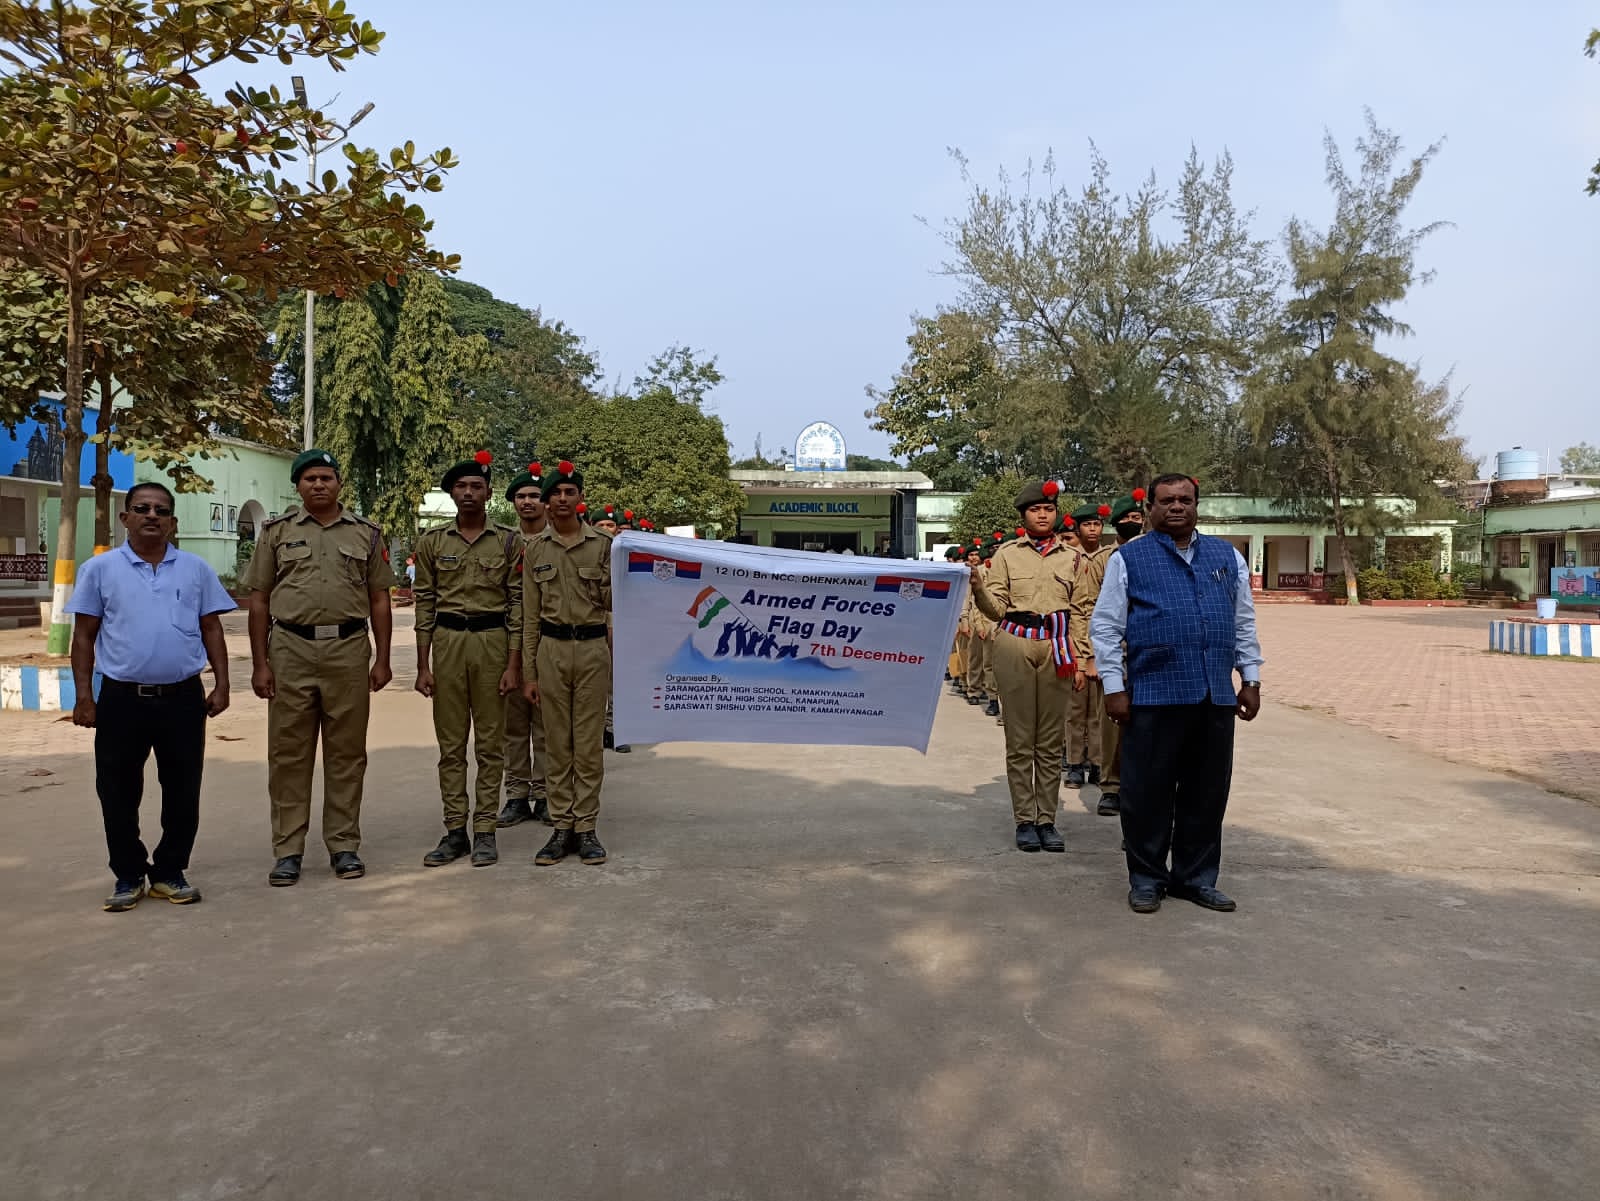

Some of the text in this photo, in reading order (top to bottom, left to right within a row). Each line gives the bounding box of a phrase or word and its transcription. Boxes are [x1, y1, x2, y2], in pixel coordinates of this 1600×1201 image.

[769, 502, 859, 513] ACADEMIC BLOCK
[715, 567, 729, 575] 12
[732, 568, 749, 578] (O)
[753, 571, 767, 580] Bn
[801, 575, 869, 587] DHENKANAL
[740, 589, 896, 617] Armed Forces
[767, 615, 862, 643] Flag Day
[810, 643, 925, 665] 7th December
[665, 674, 708, 683] Organised
[665, 685, 728, 693] SARANGADHAR
[731, 686, 750, 694] HIGH
[791, 688, 865, 699] KAMAKHYANAGAR
[664, 694, 715, 702] PANCHAYAT
[717, 694, 732, 702] RAJ
[735, 695, 755, 703] HIGH
[795, 698, 840, 706] KANAPURA
[664, 703, 713, 711] SARASWATI
[715, 703, 745, 711] SHISHU
[747, 704, 771, 712] VIDYA
[810, 706, 884, 717] KAMAKHYANAGAR
